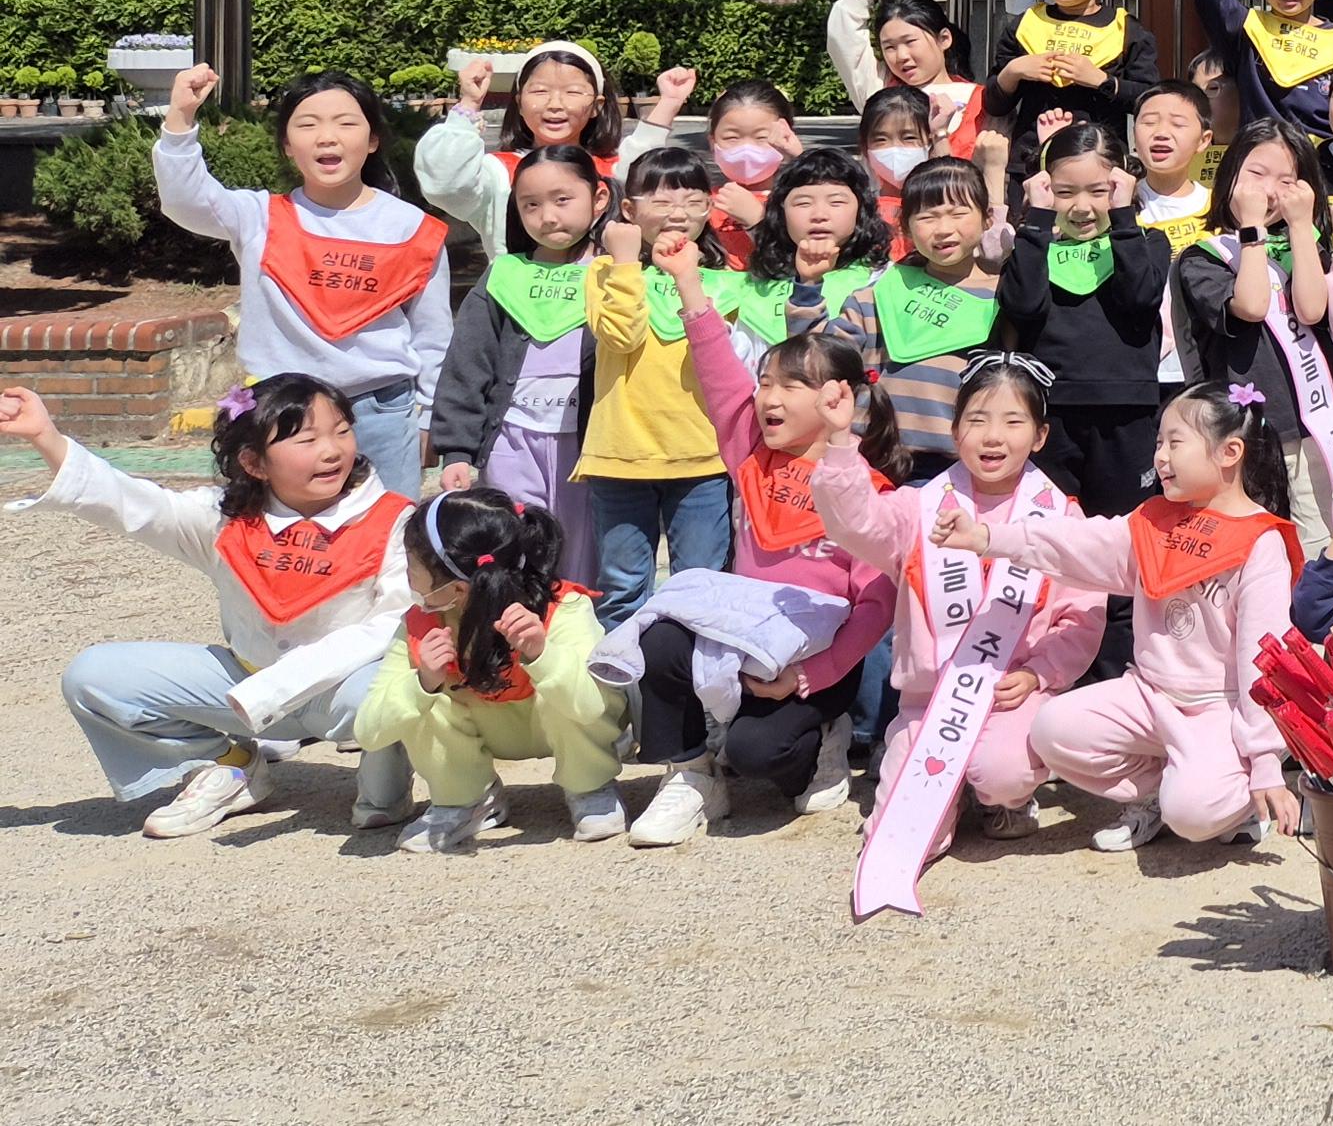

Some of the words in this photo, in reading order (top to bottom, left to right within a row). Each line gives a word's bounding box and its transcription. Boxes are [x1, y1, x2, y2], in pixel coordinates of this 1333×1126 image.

[1054, 25, 1093, 39] 팀원과
[1271, 39, 1319, 60] 협동해요
[1167, 223, 1196, 240] 원과
[321, 249, 376, 269] 상대를
[307, 268, 379, 295] 존중해요
[533, 269, 582, 282] 최선을
[529, 284, 578, 301] 다해요
[903, 299, 951, 329] 다해요
[939, 631, 1001, 742] 주인공
